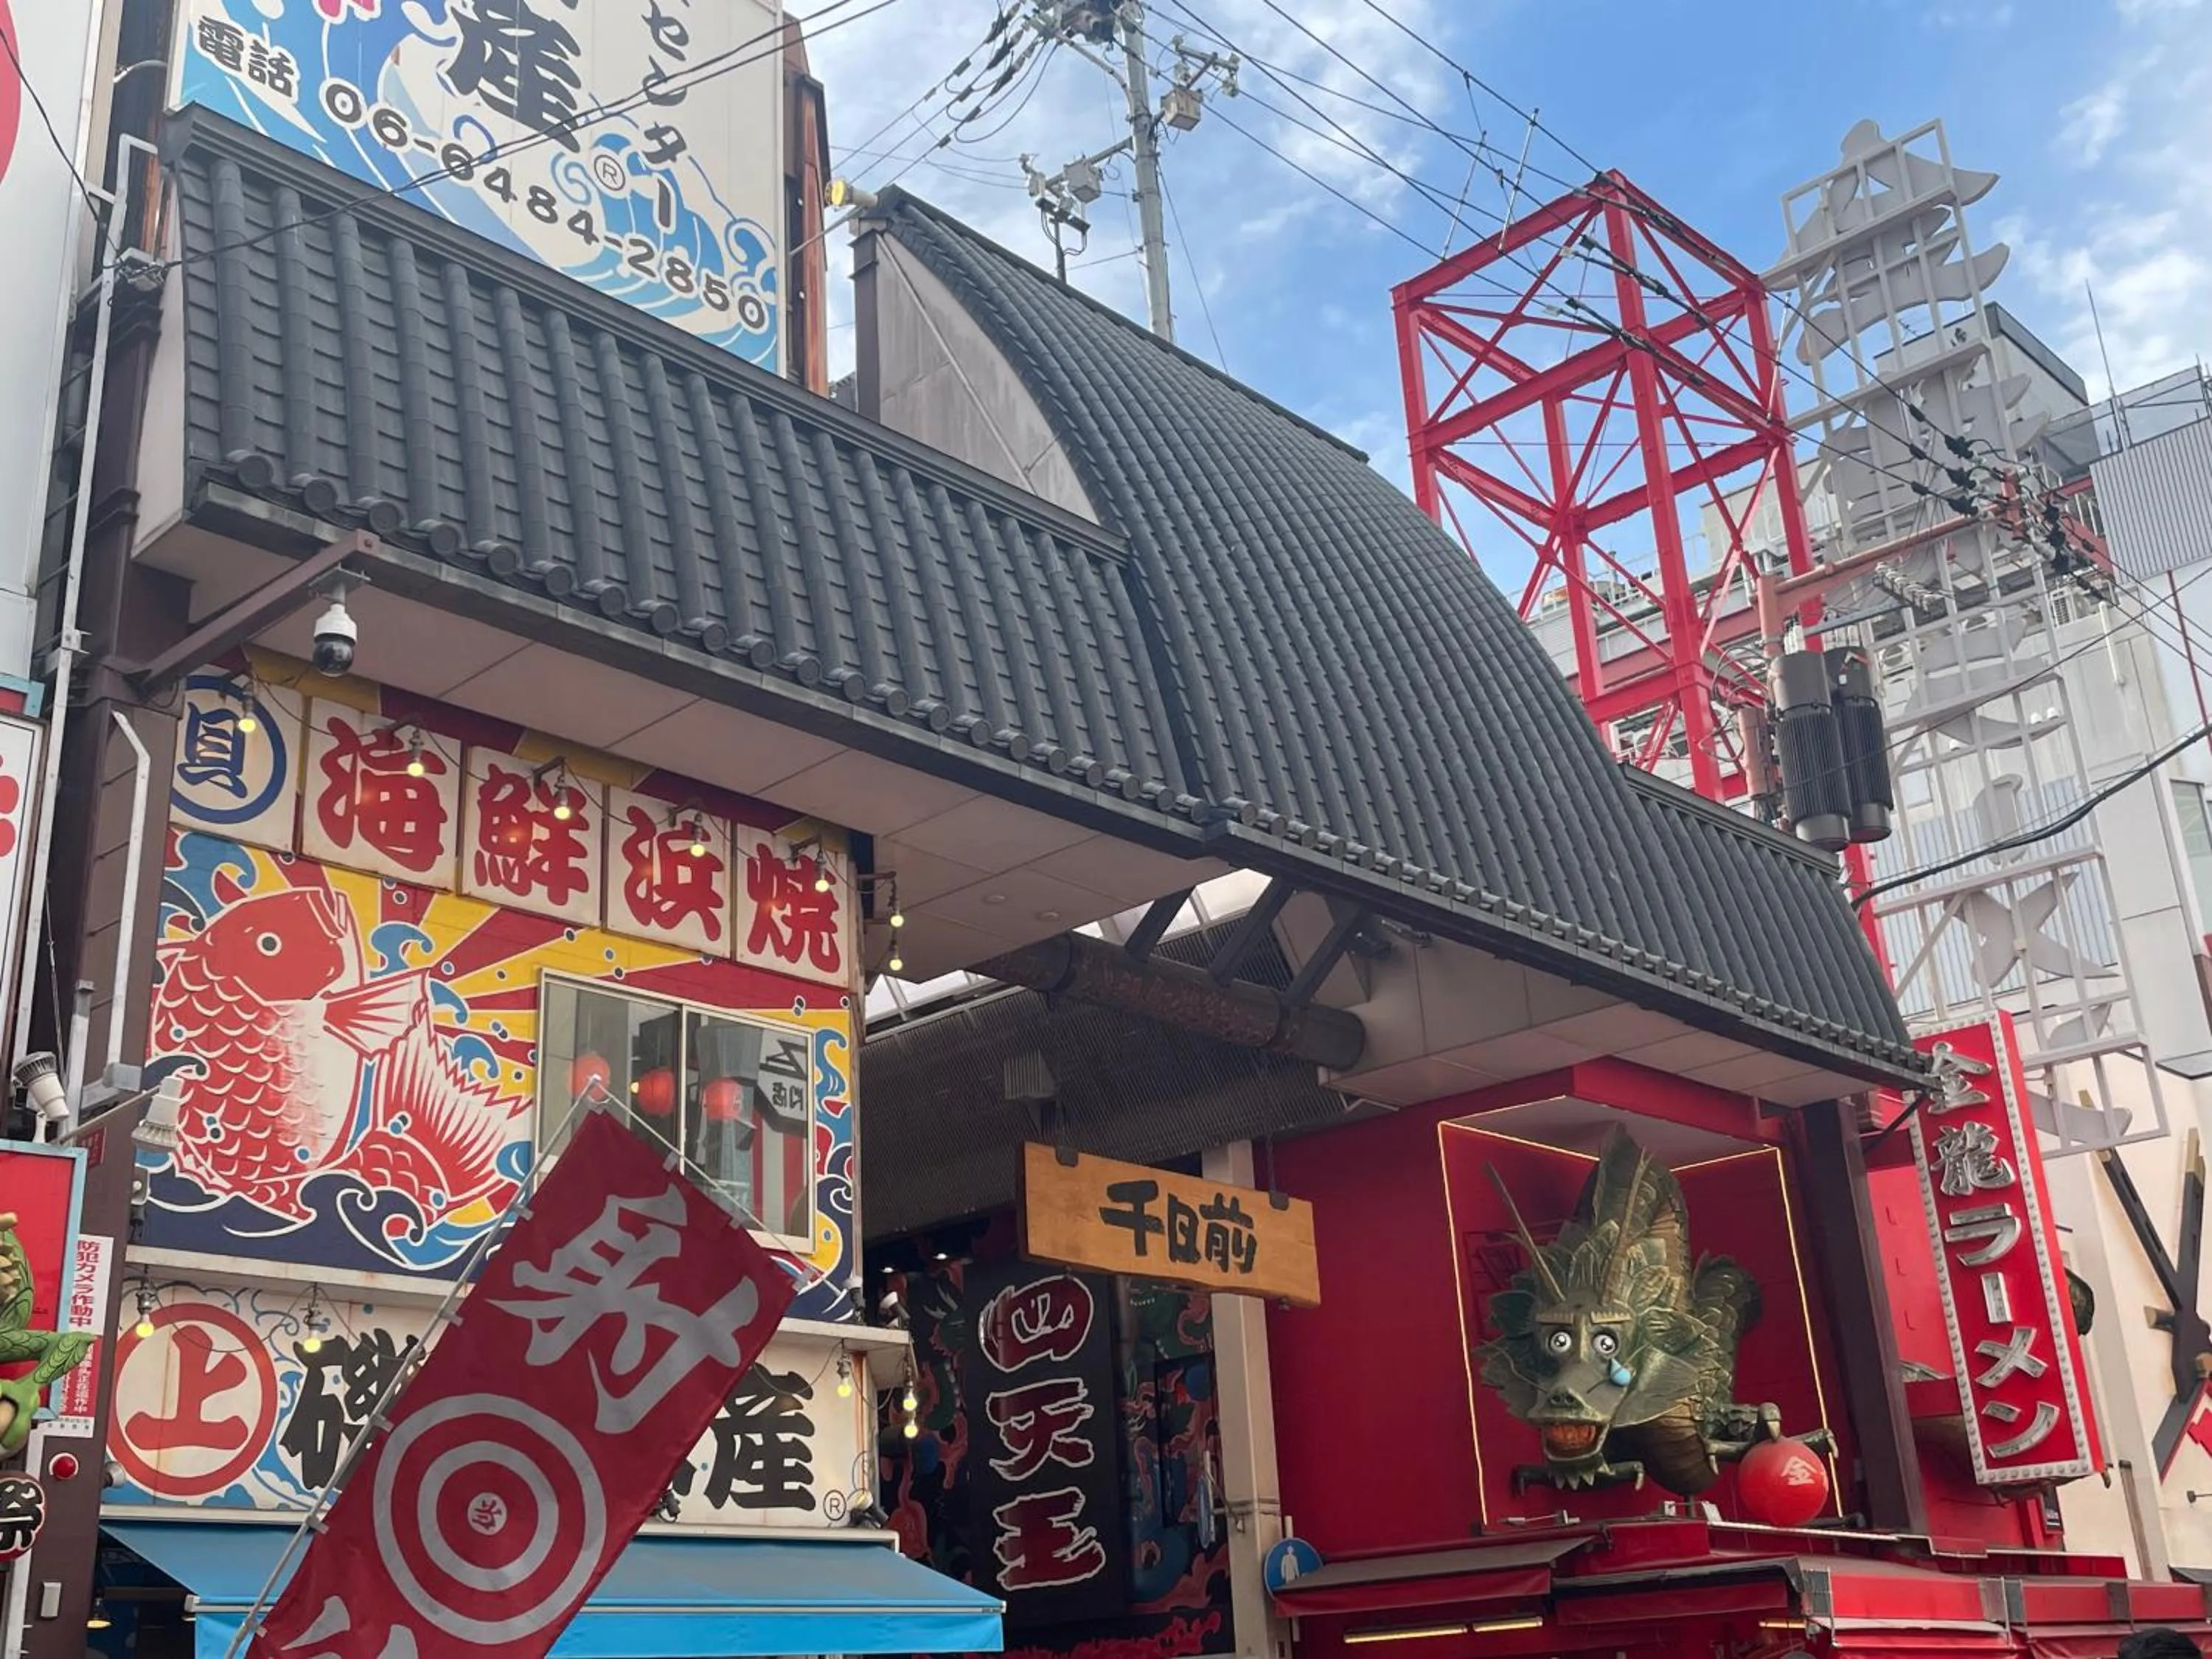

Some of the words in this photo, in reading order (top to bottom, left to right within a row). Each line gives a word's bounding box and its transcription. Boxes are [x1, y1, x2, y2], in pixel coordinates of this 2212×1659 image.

[198, 15, 294, 98] 電話
[324, 83, 766, 330] 06-6484-2850
[316, 716, 841, 973] 海鮮浜焼
[69, 1239, 101, 1326] 防犯カメラ作動中
[1099, 1179, 1258, 1274] 千日前
[1927, 1040, 2062, 1460] 金龍ラーメン
